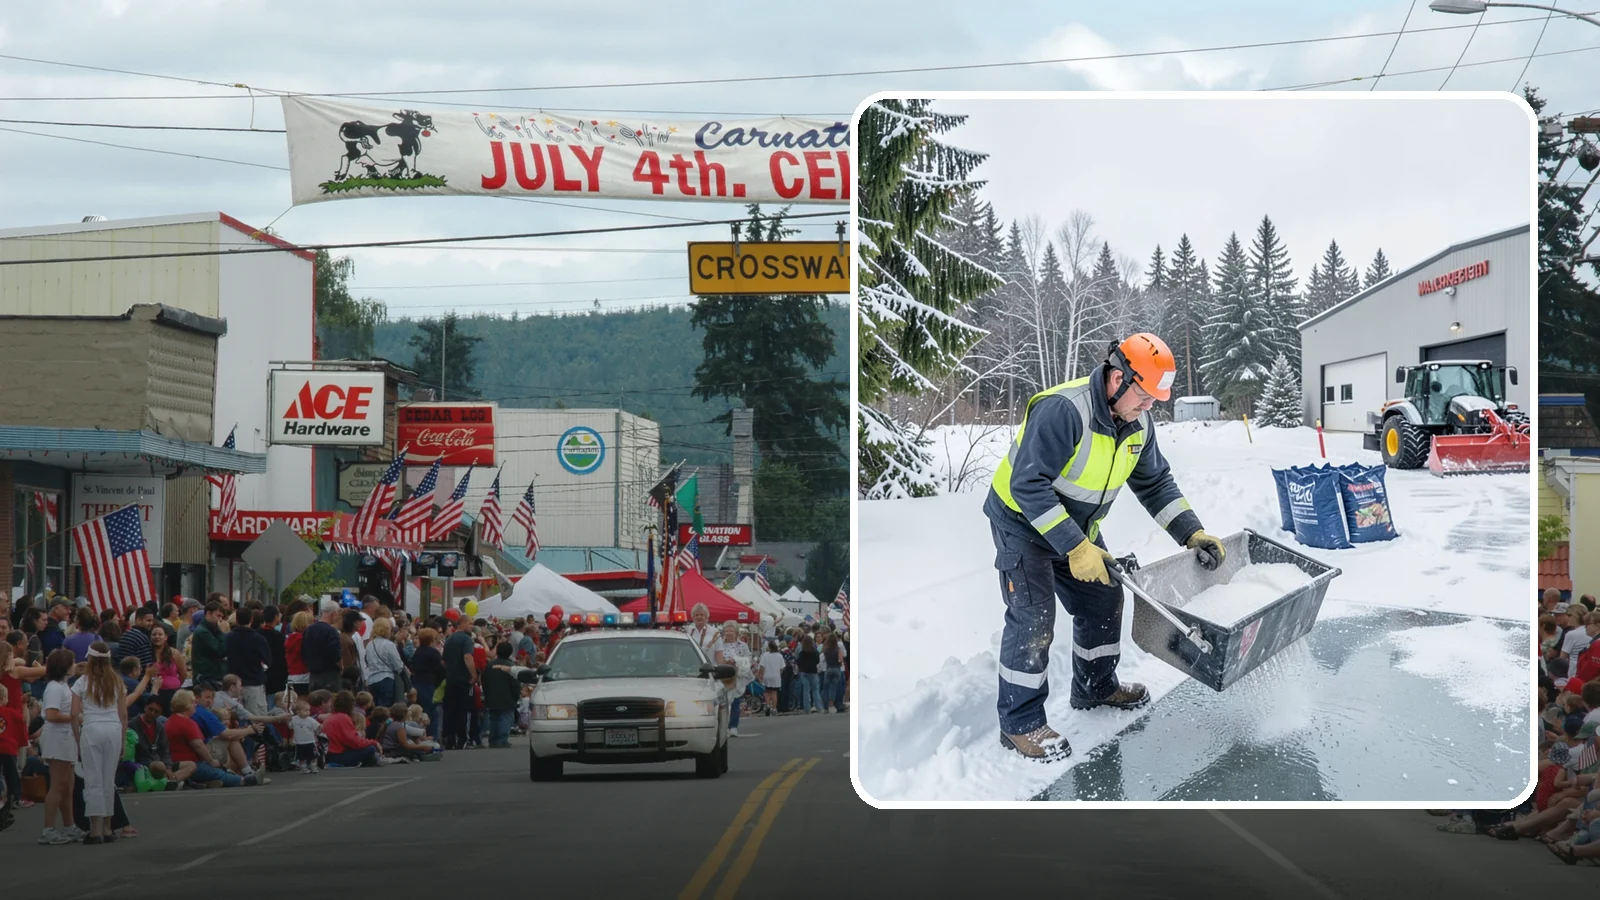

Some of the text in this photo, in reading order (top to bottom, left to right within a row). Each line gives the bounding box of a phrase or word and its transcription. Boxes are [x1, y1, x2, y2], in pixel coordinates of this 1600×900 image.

[481, 141, 605, 193] JULY
[632, 150, 746, 197] 4th.
[697, 254, 850, 280] CROSSWA
[283, 380, 373, 420] ACE
[406, 409, 485, 422] CEDAR LOG
[283, 421, 370, 436] Hardware
[353, 466, 385, 480] Simpl
[96, 485, 124, 495] Vincent
[126, 486, 136, 495] de
[137, 486, 156, 495] Paul
[212, 516, 331, 535] HARDARE
[688, 526, 741, 536] CRNATION
[699, 535, 730, 544] GLASS
